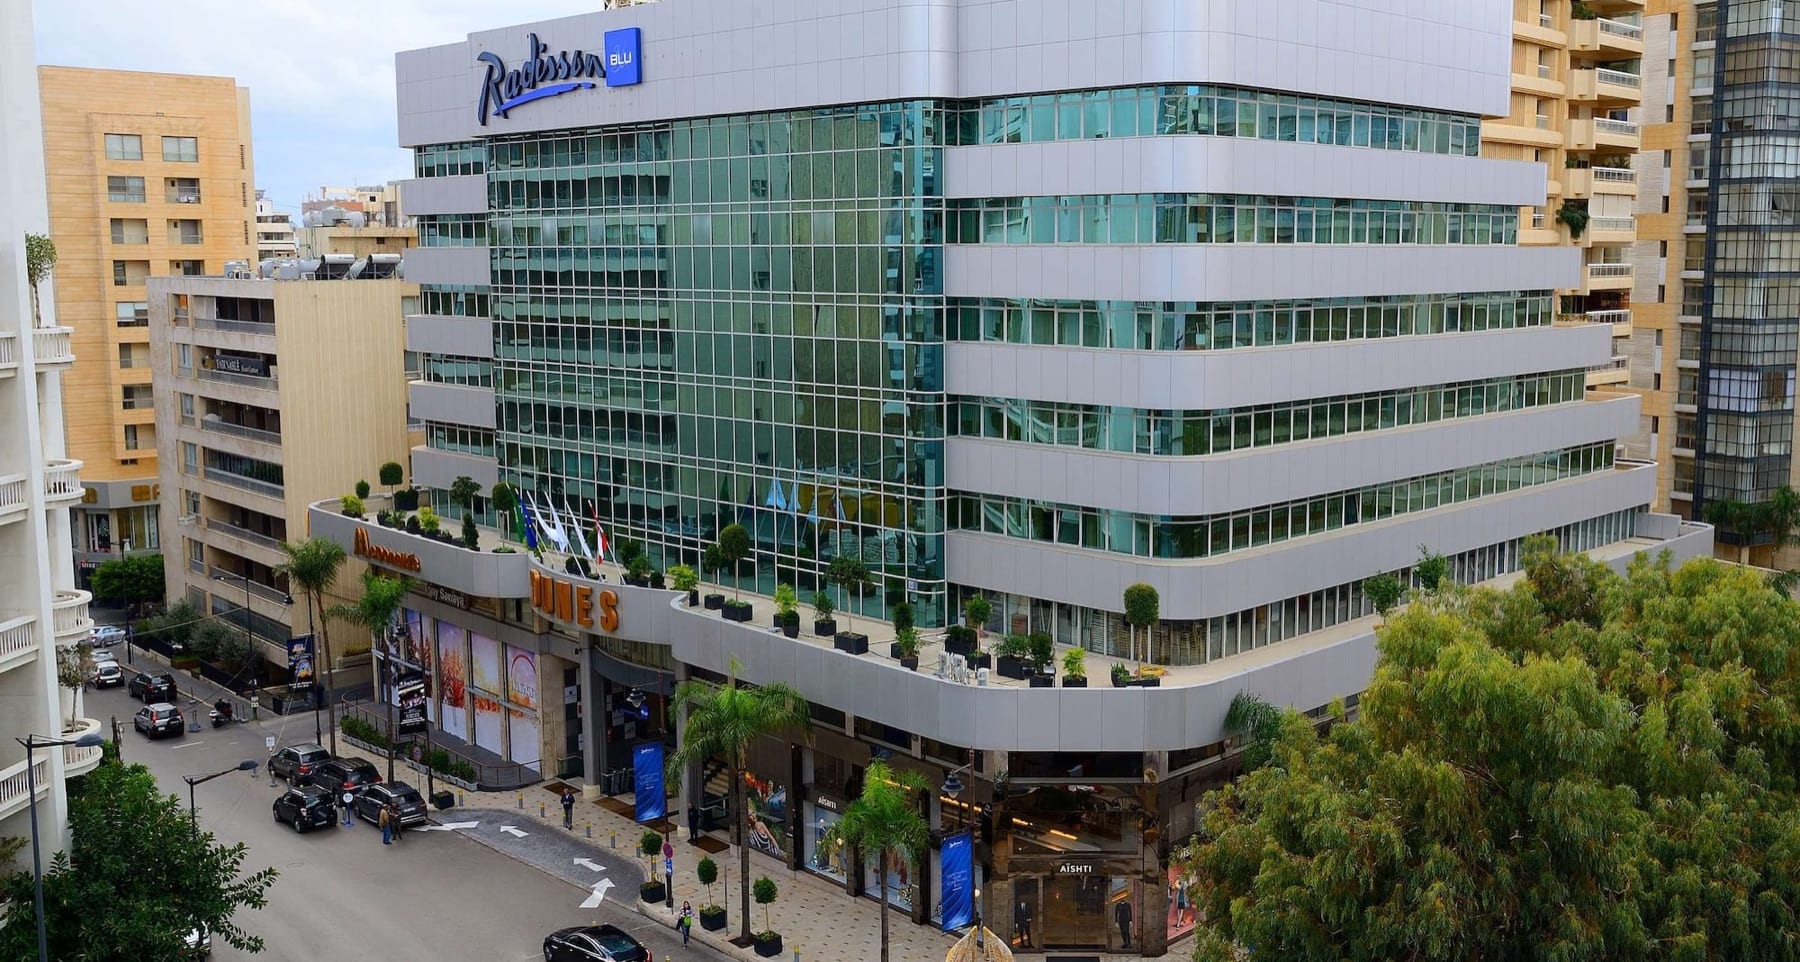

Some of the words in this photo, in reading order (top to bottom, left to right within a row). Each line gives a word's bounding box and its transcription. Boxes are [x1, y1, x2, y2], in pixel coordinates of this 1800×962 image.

[477, 33, 606, 126] Radisson
[610, 51, 632, 66] BLU
[529, 568, 619, 632] DUNES
[1060, 862, 1092, 873] AÏSHTI
